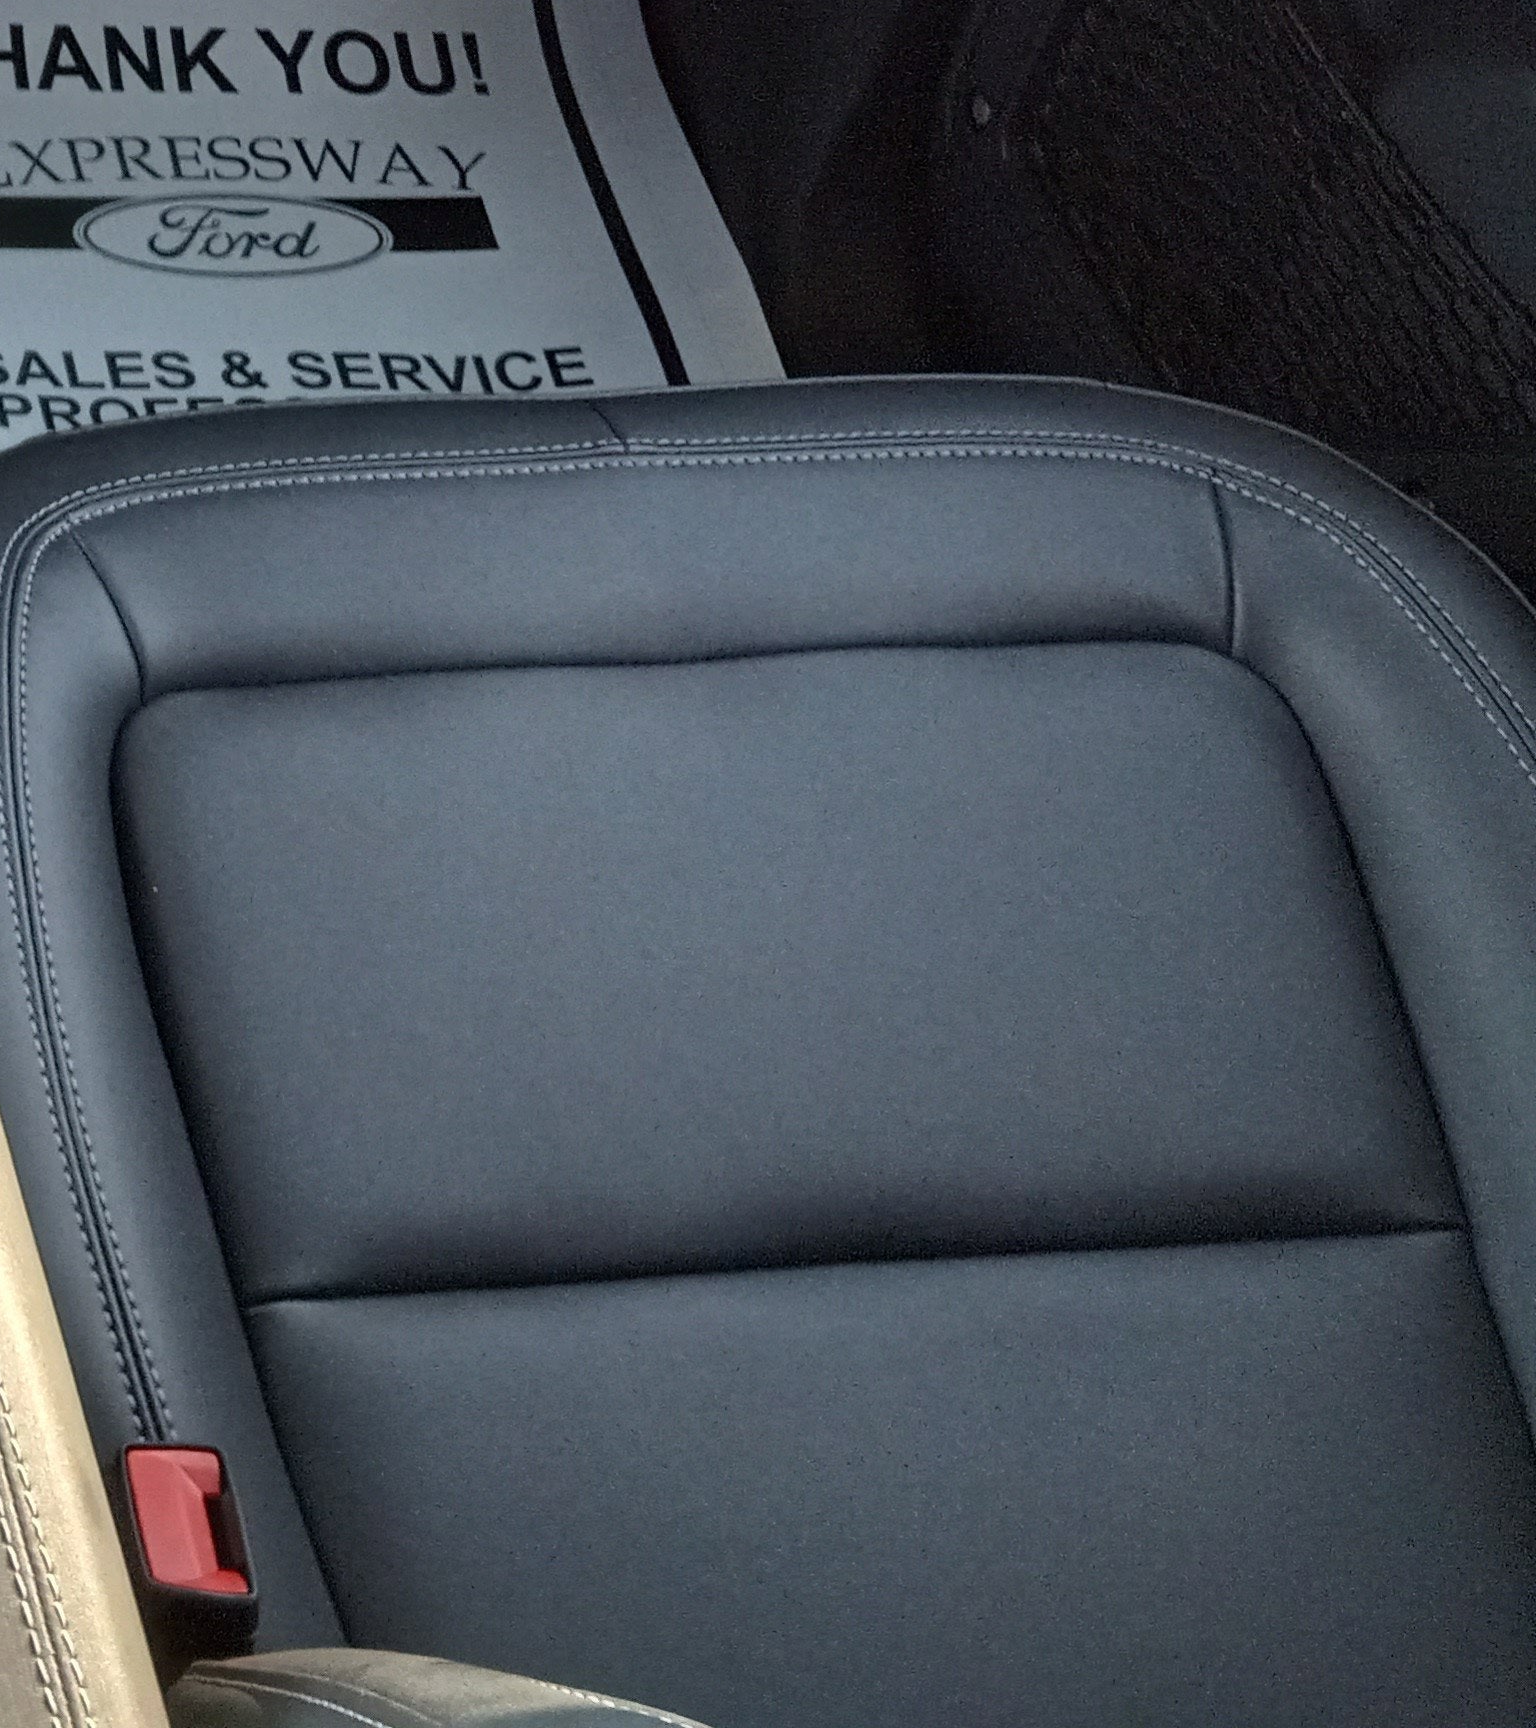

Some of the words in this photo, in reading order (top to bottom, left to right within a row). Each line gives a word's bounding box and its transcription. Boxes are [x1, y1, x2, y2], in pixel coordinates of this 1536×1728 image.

[255, 26, 491, 97] YOU!
[146, 202, 320, 263] Ford
[220, 350, 270, 389] &
[286, 345, 595, 394] SERVICE
